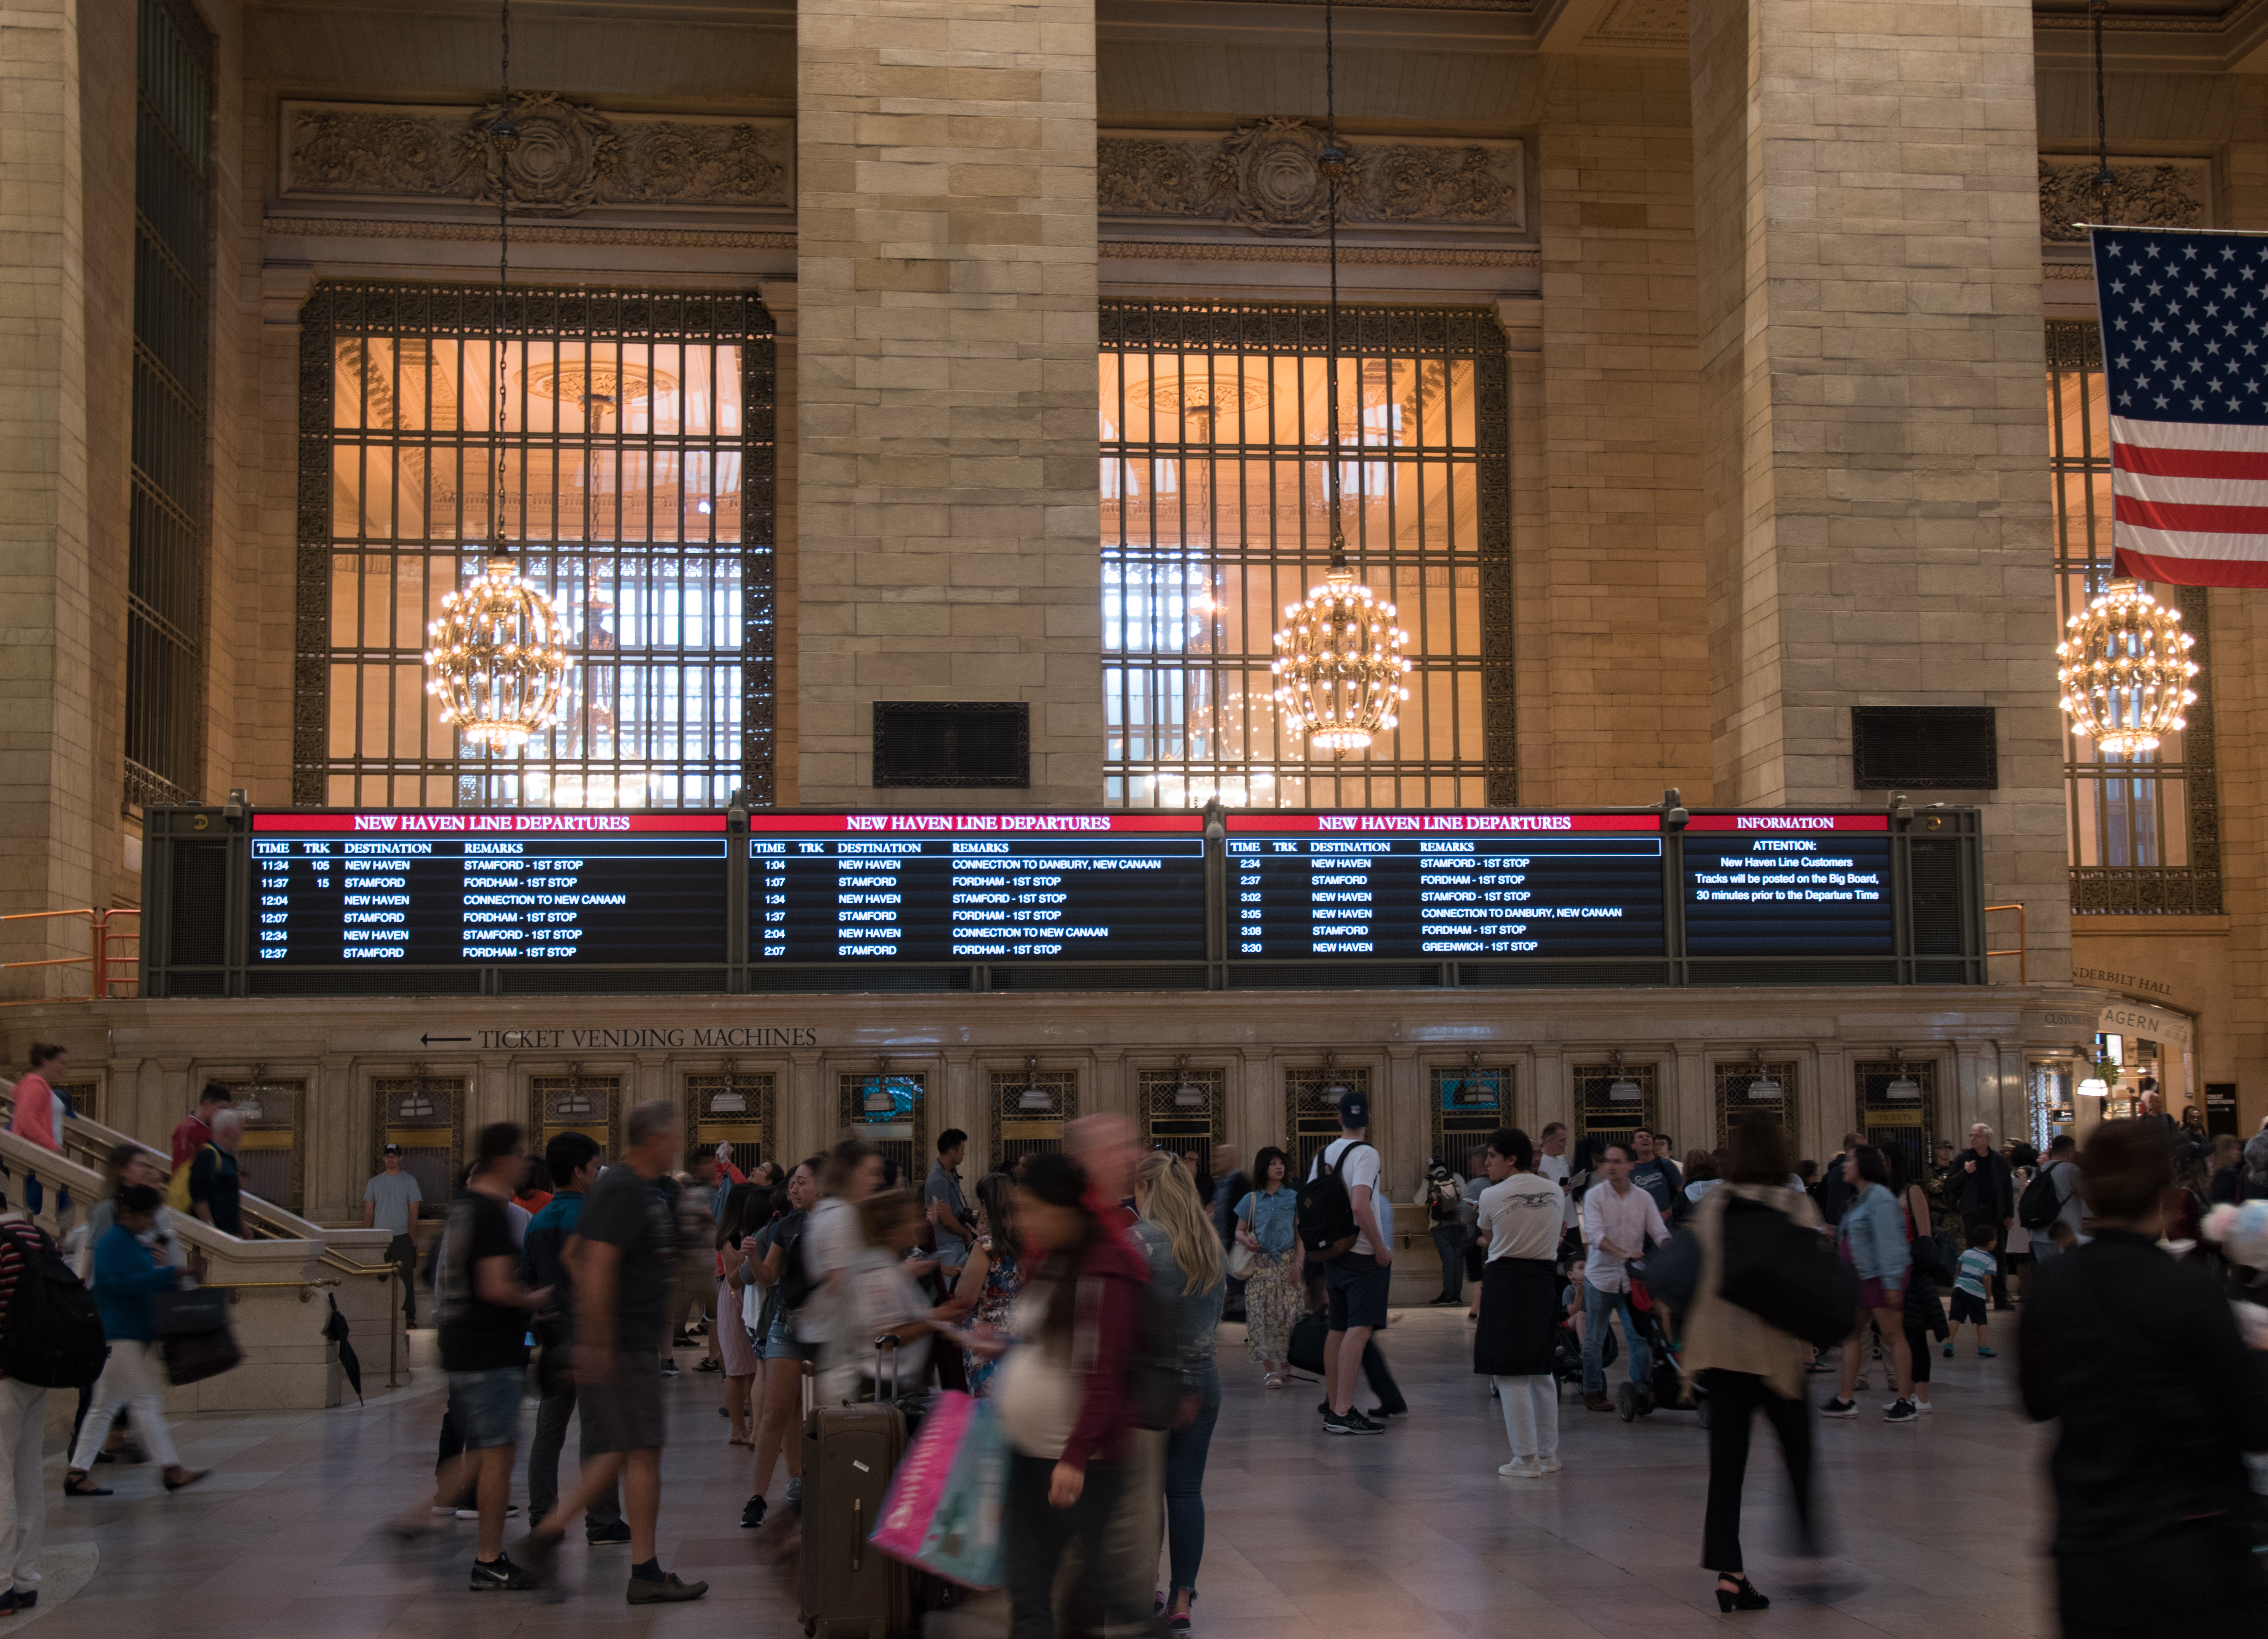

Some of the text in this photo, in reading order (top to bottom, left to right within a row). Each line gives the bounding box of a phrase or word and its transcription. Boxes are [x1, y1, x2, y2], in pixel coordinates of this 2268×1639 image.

[354, 816, 630, 830] NEW HAVEN LINE DEPARTURES
[846, 816, 1111, 830] NEW HAVEN LINE DEPARTURES
[1318, 816, 1571, 830] NEW HAVEN LINE DEPARTURES
[1737, 818, 1834, 828] INFORMATION
[257, 843, 290, 853] TIME
[303, 843, 331, 853] TRK
[344, 843, 432, 853] DESTINATION
[464, 843, 523, 853] REMARKS
[754, 843, 786, 853] TIME
[798, 843, 824, 853] TRK
[837, 843, 921, 853] DESTINATION
[952, 843, 1009, 853] REMARKS
[1230, 842, 1261, 852] TIME
[1272, 842, 1298, 852] TRK
[1310, 842, 1390, 852] DESTINATION
[1420, 842, 1474, 852] REMARKS
[1753, 840, 1817, 851] ATTENTION:
[262, 861, 289, 870] 11:34
[312, 861, 330, 870] 105
[345, 860, 410, 870] NEW HAVEN
[464, 860, 524, 870] STAMFORD
[532, 860, 553, 870] 1ST
[554, 860, 583, 870] STOP
[765, 860, 786, 870] 1:04
[839, 860, 901, 870] NEW HAVEN
[952, 859, 1161, 870] CONNECTION TO DANBURY, NEW CANAAN
[1240, 859, 1261, 868] 2:34
[1311, 859, 1371, 868] NEW HAVEN
[1721, 857, 1853, 867] New Haven Line Customers
[262, 878, 289, 888] 11:37
[317, 878, 330, 888] 15
[344, 878, 406, 888] STAMFORD
[464, 878, 518, 888] FORDHAM
[526, 878, 547, 888] 1ST
[548, 878, 577, 888] STOP
[765, 878, 786, 887] 1:07
[838, 877, 897, 887] STAMFORD
[1241, 876, 1261, 885] 2:37
[1311, 875, 1367, 885] STAMFORD
[1694, 873, 1879, 886] Tracks will be posted on the Big Board,
[261, 896, 289, 905] 12:04
[344, 895, 410, 905] NEW HAVEN
[463, 895, 626, 905] CONNECTION TO NEW CANAAN
[765, 894, 786, 904] 1:34
[839, 894, 901, 904] NEW HAVEN
[952, 894, 1010, 904] STAMFORD
[1018, 894, 1038, 903] 1ST
[1038, 894, 1067, 903] STOP
[1241, 893, 1261, 902] 3:02
[1312, 892, 1372, 902] NEW HAVEN
[1696, 890, 1879, 902] 30 minutes prior to the Departure Time
[261, 913, 288, 923] 12:07
[344, 913, 405, 923] STAMFORD
[765, 912, 786, 921] 1:37
[838, 911, 897, 921] STAMFORD
[1241, 910, 1261, 918] 3:05
[1312, 909, 1372, 918] NEW HAVEN
[1421, 908, 1622, 918] CONNECTION TO DANBURY, NEW CANAAN
[344, 930, 409, 940] NEW HAVEN
[764, 929, 786, 938] 2:04
[839, 928, 901, 938] NEW HAVEN
[952, 927, 1108, 937] CONNECTION TO NEW CANAAN
[1241, 927, 1262, 936] 3:08
[1312, 926, 1368, 935] STAMFORD
[1422, 925, 1471, 935] FORDHAM
[1479, 925, 1498, 935] 1ST
[1499, 925, 1526, 935] STOP
[260, 931, 288, 941] 12:34
[764, 946, 786, 956] 2:07
[839, 945, 897, 956] STAMFORD
[953, 945, 1005, 955] FORDHAM
[1013, 945, 1032, 954] 1ST
[1033, 945, 1062, 954] STOP
[1241, 943, 1262, 952] 3:30
[1313, 943, 1373, 952] NEW HAVEN
[1422, 942, 1483, 951] GREENWICH
[1491, 942, 1509, 951] 1ST
[1510, 941, 1538, 951] STOP
[260, 948, 287, 958] 12:37
[343, 948, 404, 958] STAMFORD
[2138, 978, 2172, 995] HALL
[2105, 1009, 2159, 1032] AGERN
[478, 1028, 816, 1048] TICKET VENDING MACHINES
